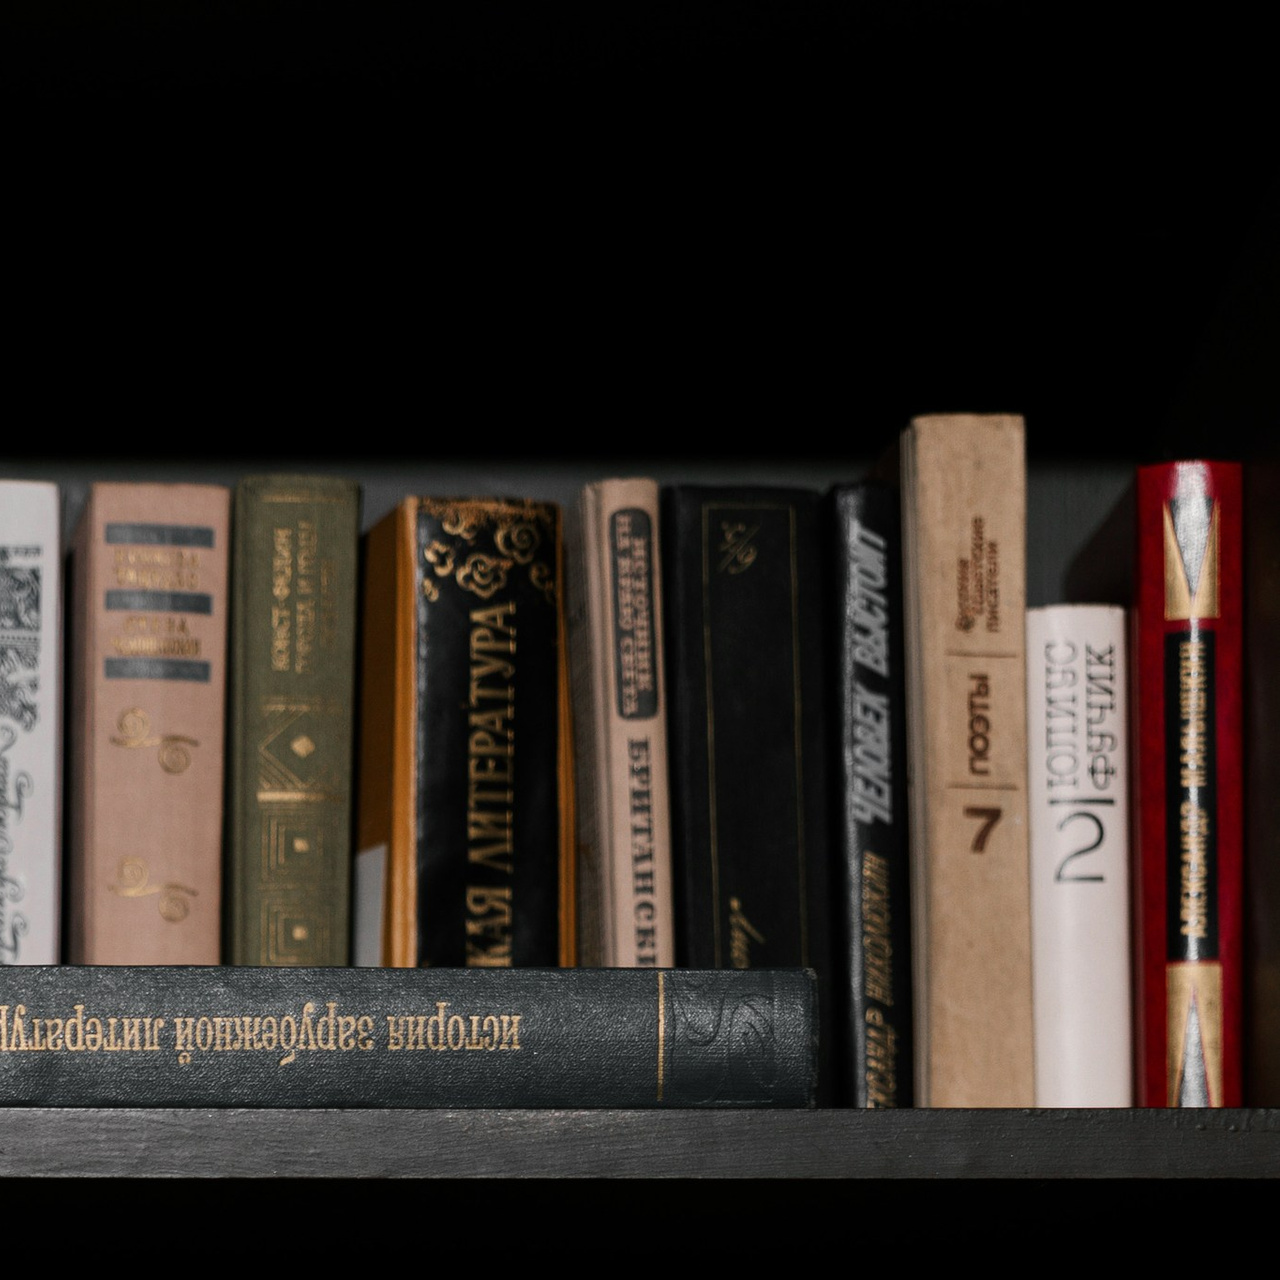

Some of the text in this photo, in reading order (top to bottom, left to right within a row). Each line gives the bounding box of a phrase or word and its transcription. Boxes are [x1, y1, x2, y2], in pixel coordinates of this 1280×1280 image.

[615, 513, 633, 551] НА
[632, 537, 653, 692] ИСТОЧНИК
[620, 636, 639, 716] СВЕТА
[846, 517, 893, 826] ЧЕЛОВЕК ВЫСТОИТ
[1043, 638, 1079, 790] ЮЛИУС
[1084, 642, 1118, 791] ФУЧИК
[466, 600, 517, 876] ЛИТЕРАТУРА
[967, 673, 991, 777] ПОЭТЫ
[964, 805, 1002, 854] 7
[1055, 811, 1106, 883] 2
[173, 1001, 375, 1067] зарубежной
